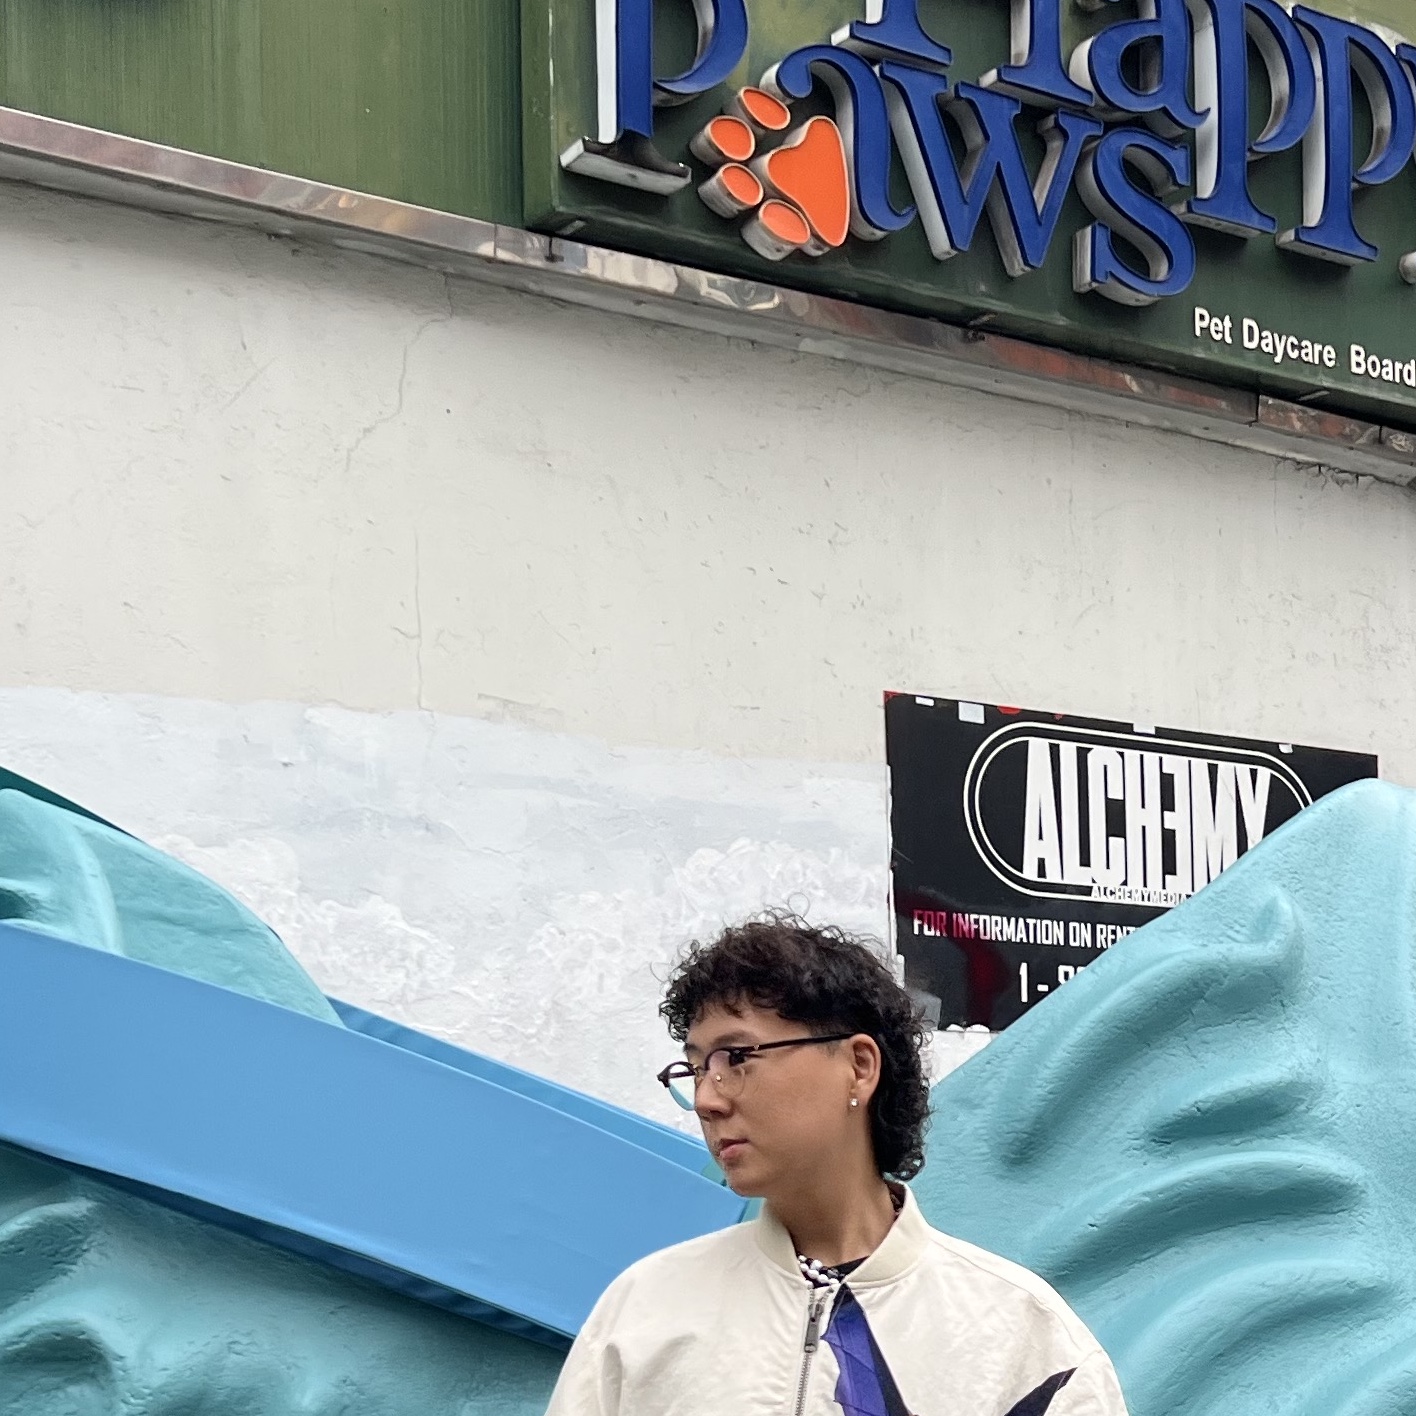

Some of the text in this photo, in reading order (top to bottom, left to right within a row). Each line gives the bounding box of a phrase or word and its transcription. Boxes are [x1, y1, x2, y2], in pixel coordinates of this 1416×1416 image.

[1194, 306, 1233, 345] Pet
[1242, 318, 1337, 368] Daycare
[913, 909, 947, 937] FOR
[952, 912, 1065, 946] INFORMATION
[1069, 921, 1092, 948] ON
[1019, 962, 1028, 1003] 1
